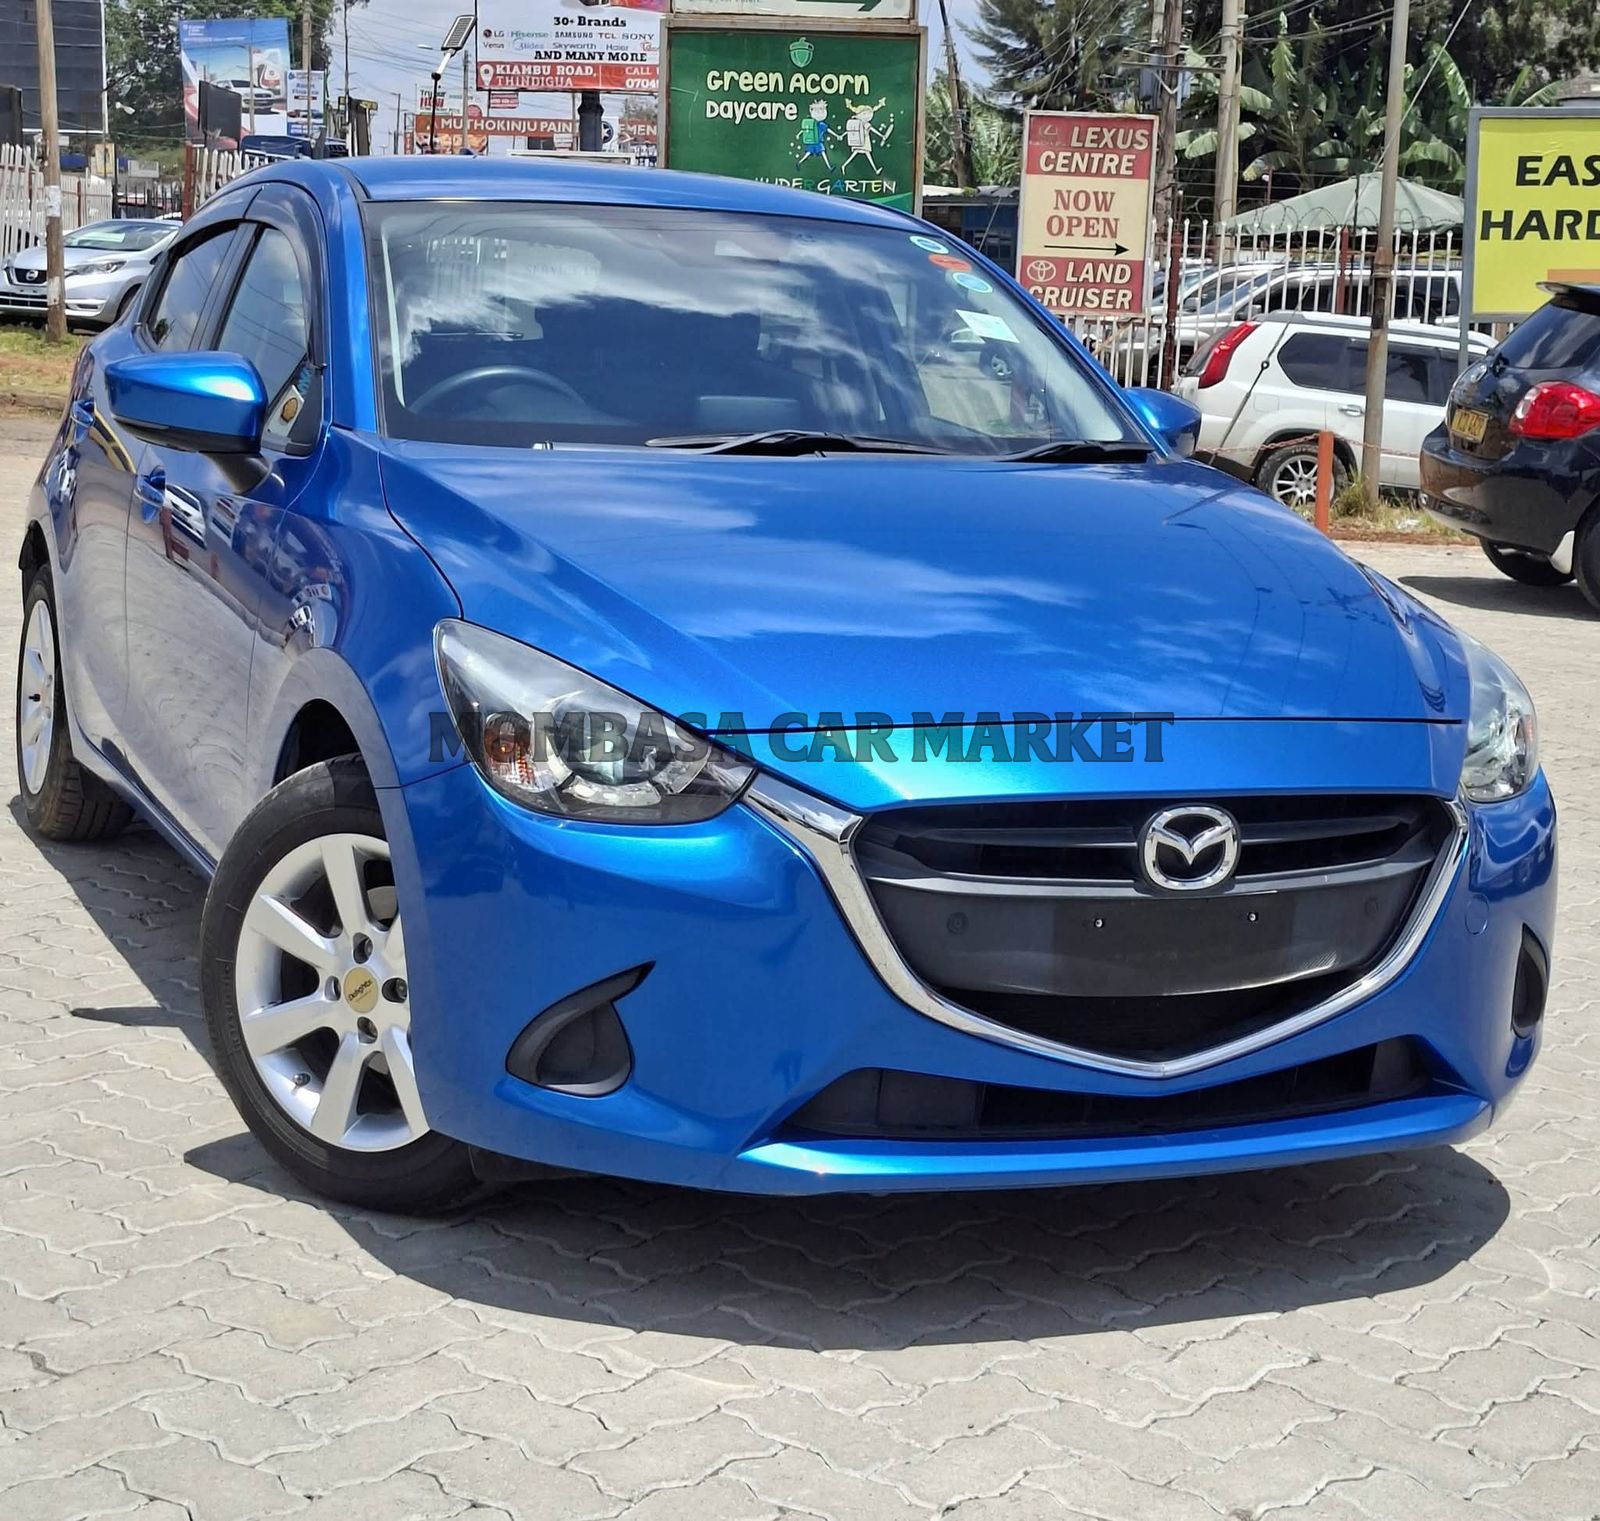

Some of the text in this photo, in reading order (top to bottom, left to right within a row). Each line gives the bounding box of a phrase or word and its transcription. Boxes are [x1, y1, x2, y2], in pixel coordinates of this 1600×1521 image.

[553, 15, 627, 27] 30+ Brands
[510, 30, 549, 38] Hisense
[622, 32, 655, 40] SONY
[552, 42, 597, 50] Skyworth
[534, 50, 648, 62] AND MANY MORE
[495, 65, 597, 77] KIAMBU ROAD,
[625, 66, 652, 76] CALL
[495, 75, 574, 87] THINDIGUA
[706, 69, 870, 96] Green Acorn
[705, 99, 799, 124] Daycare
[440, 118, 538, 133] MUTHOKINJU
[539, 121, 579, 133] PAIN
[1069, 126, 1150, 150] LEXUS
[1039, 150, 1137, 176] CENTRE
[1053, 188, 1116, 213] NOW
[1045, 214, 1120, 239] OPEN
[1065, 261, 1132, 285] LAND
[1028, 285, 1133, 310] CRUISER
